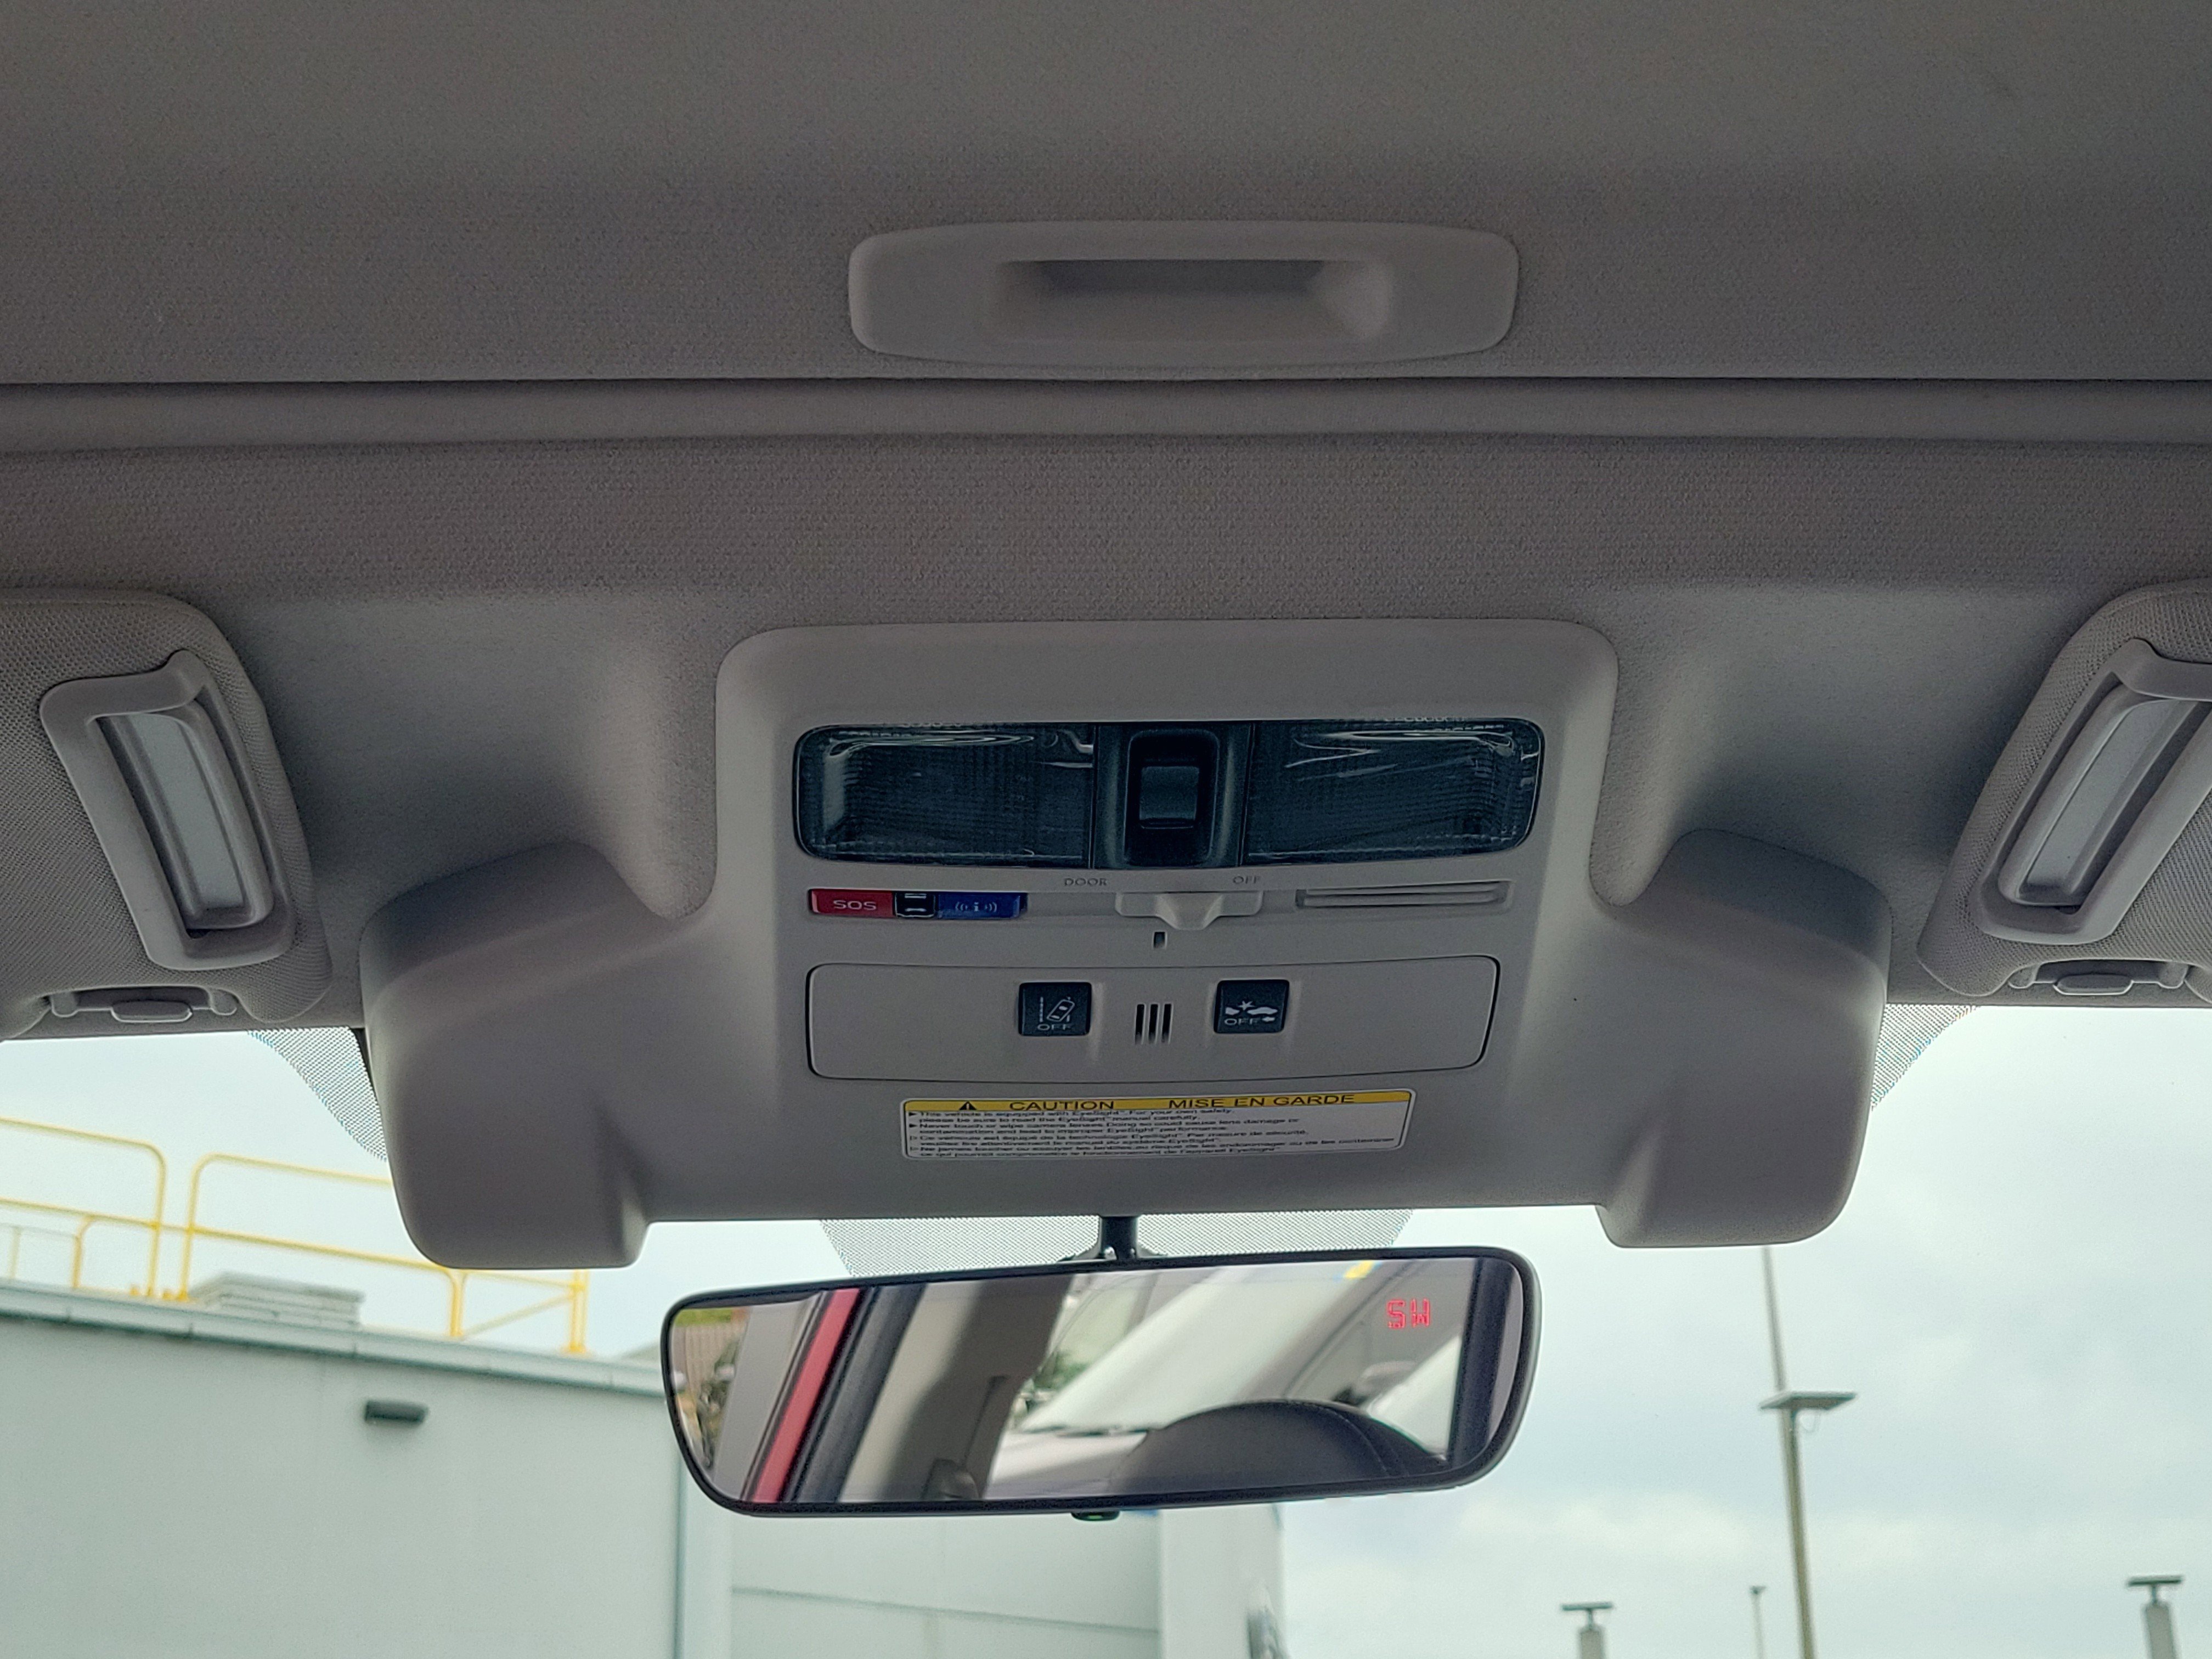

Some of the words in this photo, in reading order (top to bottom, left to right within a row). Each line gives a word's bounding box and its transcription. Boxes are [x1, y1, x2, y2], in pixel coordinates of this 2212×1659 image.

[1064, 877, 1108, 886] DOOR
[1233, 876, 1260, 884] OFF
[833, 899, 877, 911] SOS
[1223, 1018, 1261, 1026] OFF
[1009, 1101, 1115, 1111] CAUTION
[1169, 1098, 1223, 1109] MISE
[1234, 1097, 1265, 1107] EN
[1273, 1095, 1355, 1105] GARDE
[1387, 1298, 1430, 1329] SW
